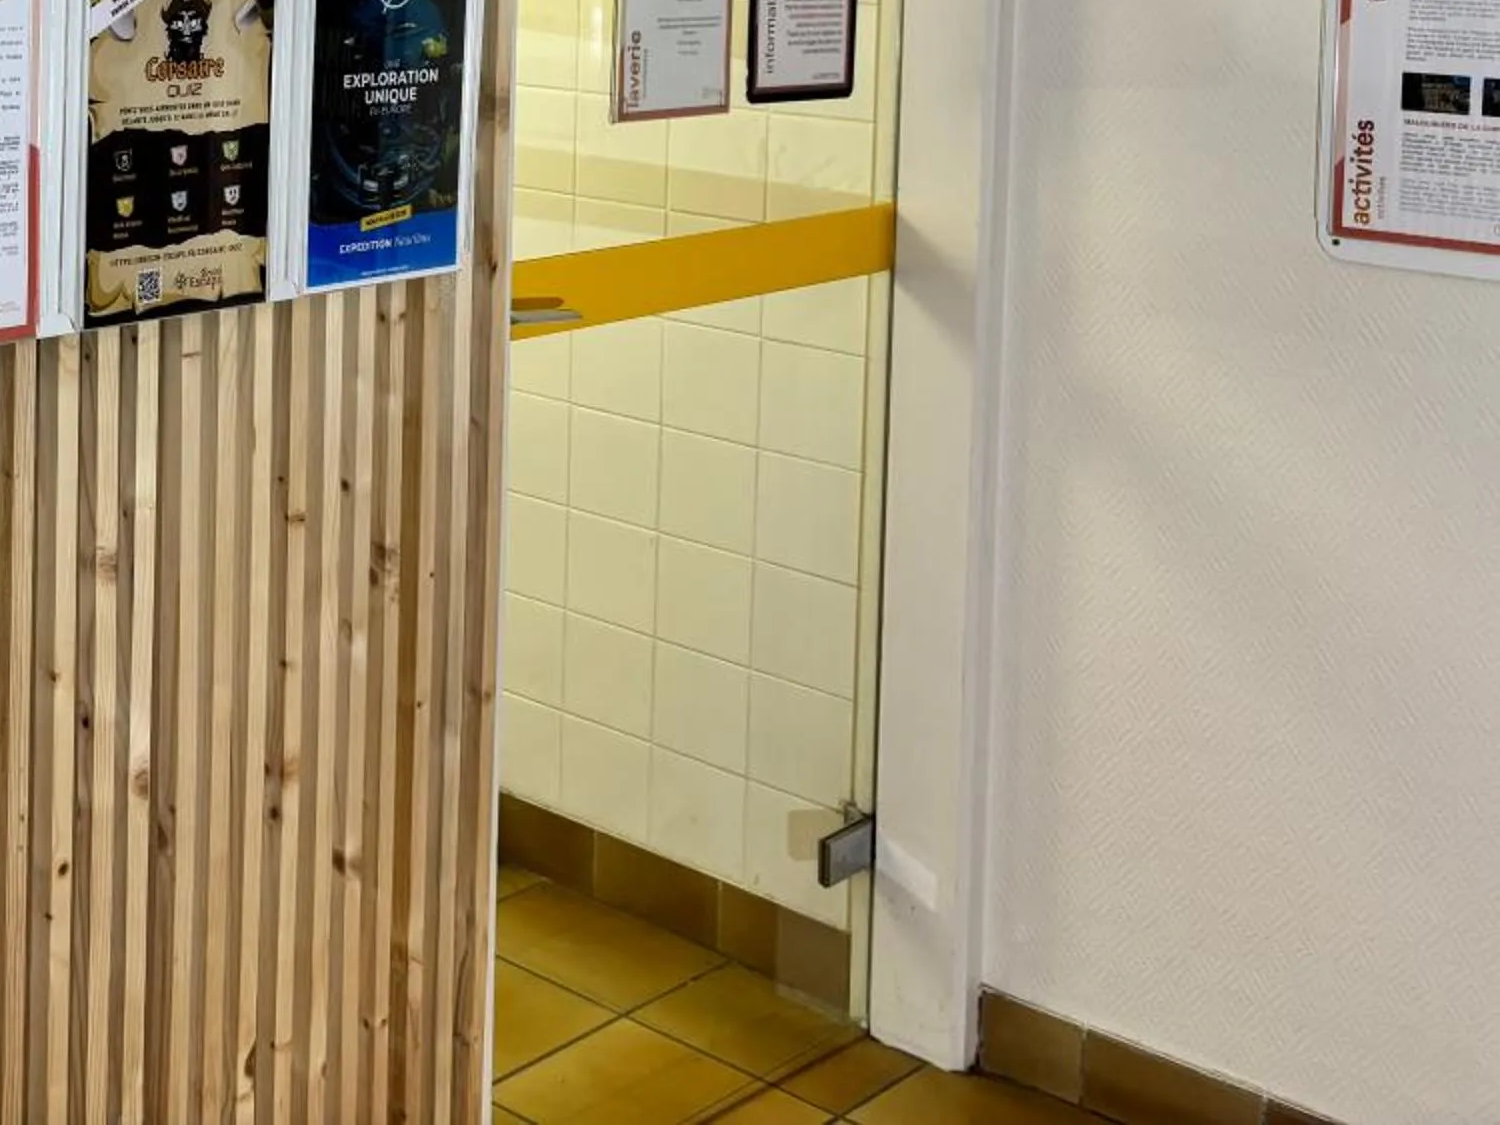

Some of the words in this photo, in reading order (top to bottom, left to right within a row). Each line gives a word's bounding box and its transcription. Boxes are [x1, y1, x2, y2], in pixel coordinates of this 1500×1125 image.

[343, 68, 439, 88] EXPLORATION
[365, 87, 418, 104] UNIQUE
[1348, 119, 1375, 225] activités
